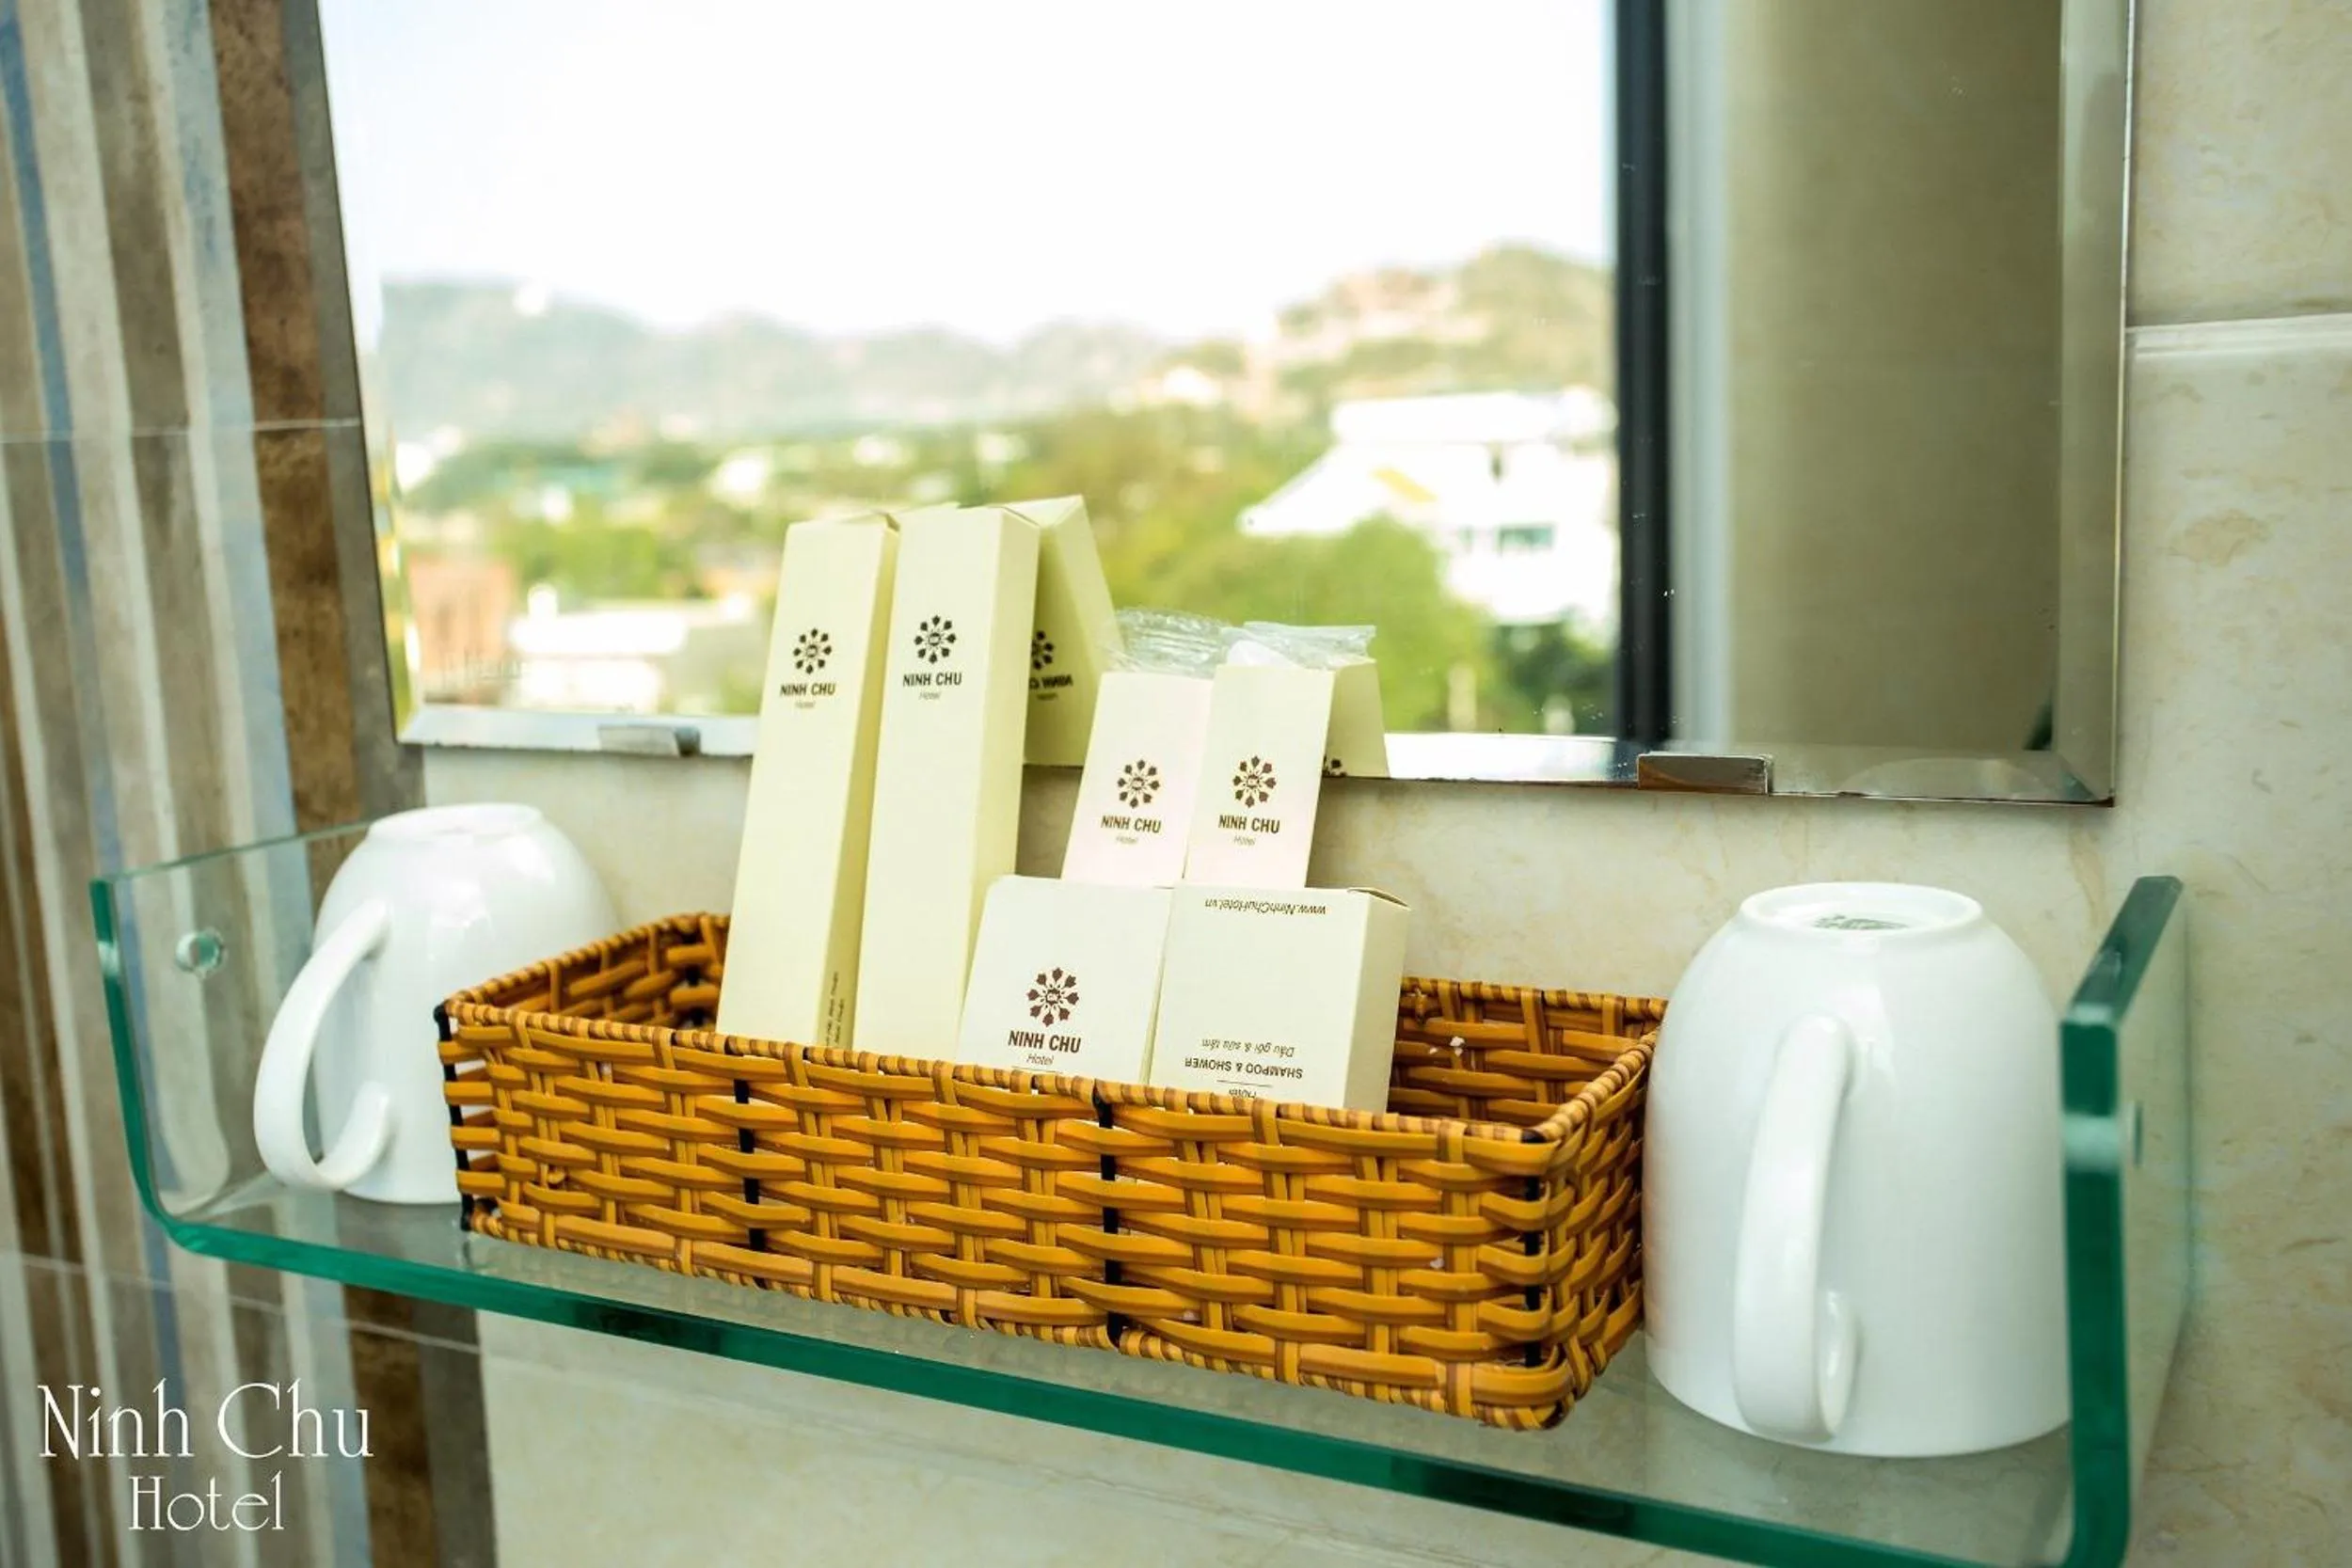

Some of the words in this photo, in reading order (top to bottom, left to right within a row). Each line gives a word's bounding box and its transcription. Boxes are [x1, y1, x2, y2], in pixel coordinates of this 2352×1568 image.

[902, 673, 931, 687] NINH
[935, 672, 961, 686] CHU
[780, 683, 807, 696] NINH
[811, 682, 836, 696] CHU
[1101, 815, 1131, 830] NINH
[1134, 817, 1162, 833] CHU
[1217, 815, 1248, 831] NINH
[1251, 816, 1280, 833] CHU
[1008, 1030, 1044, 1049] NINH
[1049, 1034, 1081, 1053] CHU
[1245, 1042, 1252, 1053] &
[1026, 1053, 1055, 1065] Hotel
[1184, 1057, 1232, 1072] SHOWER
[1236, 1062, 1243, 1072] &
[1247, 1063, 1304, 1080] SHAMPOO
